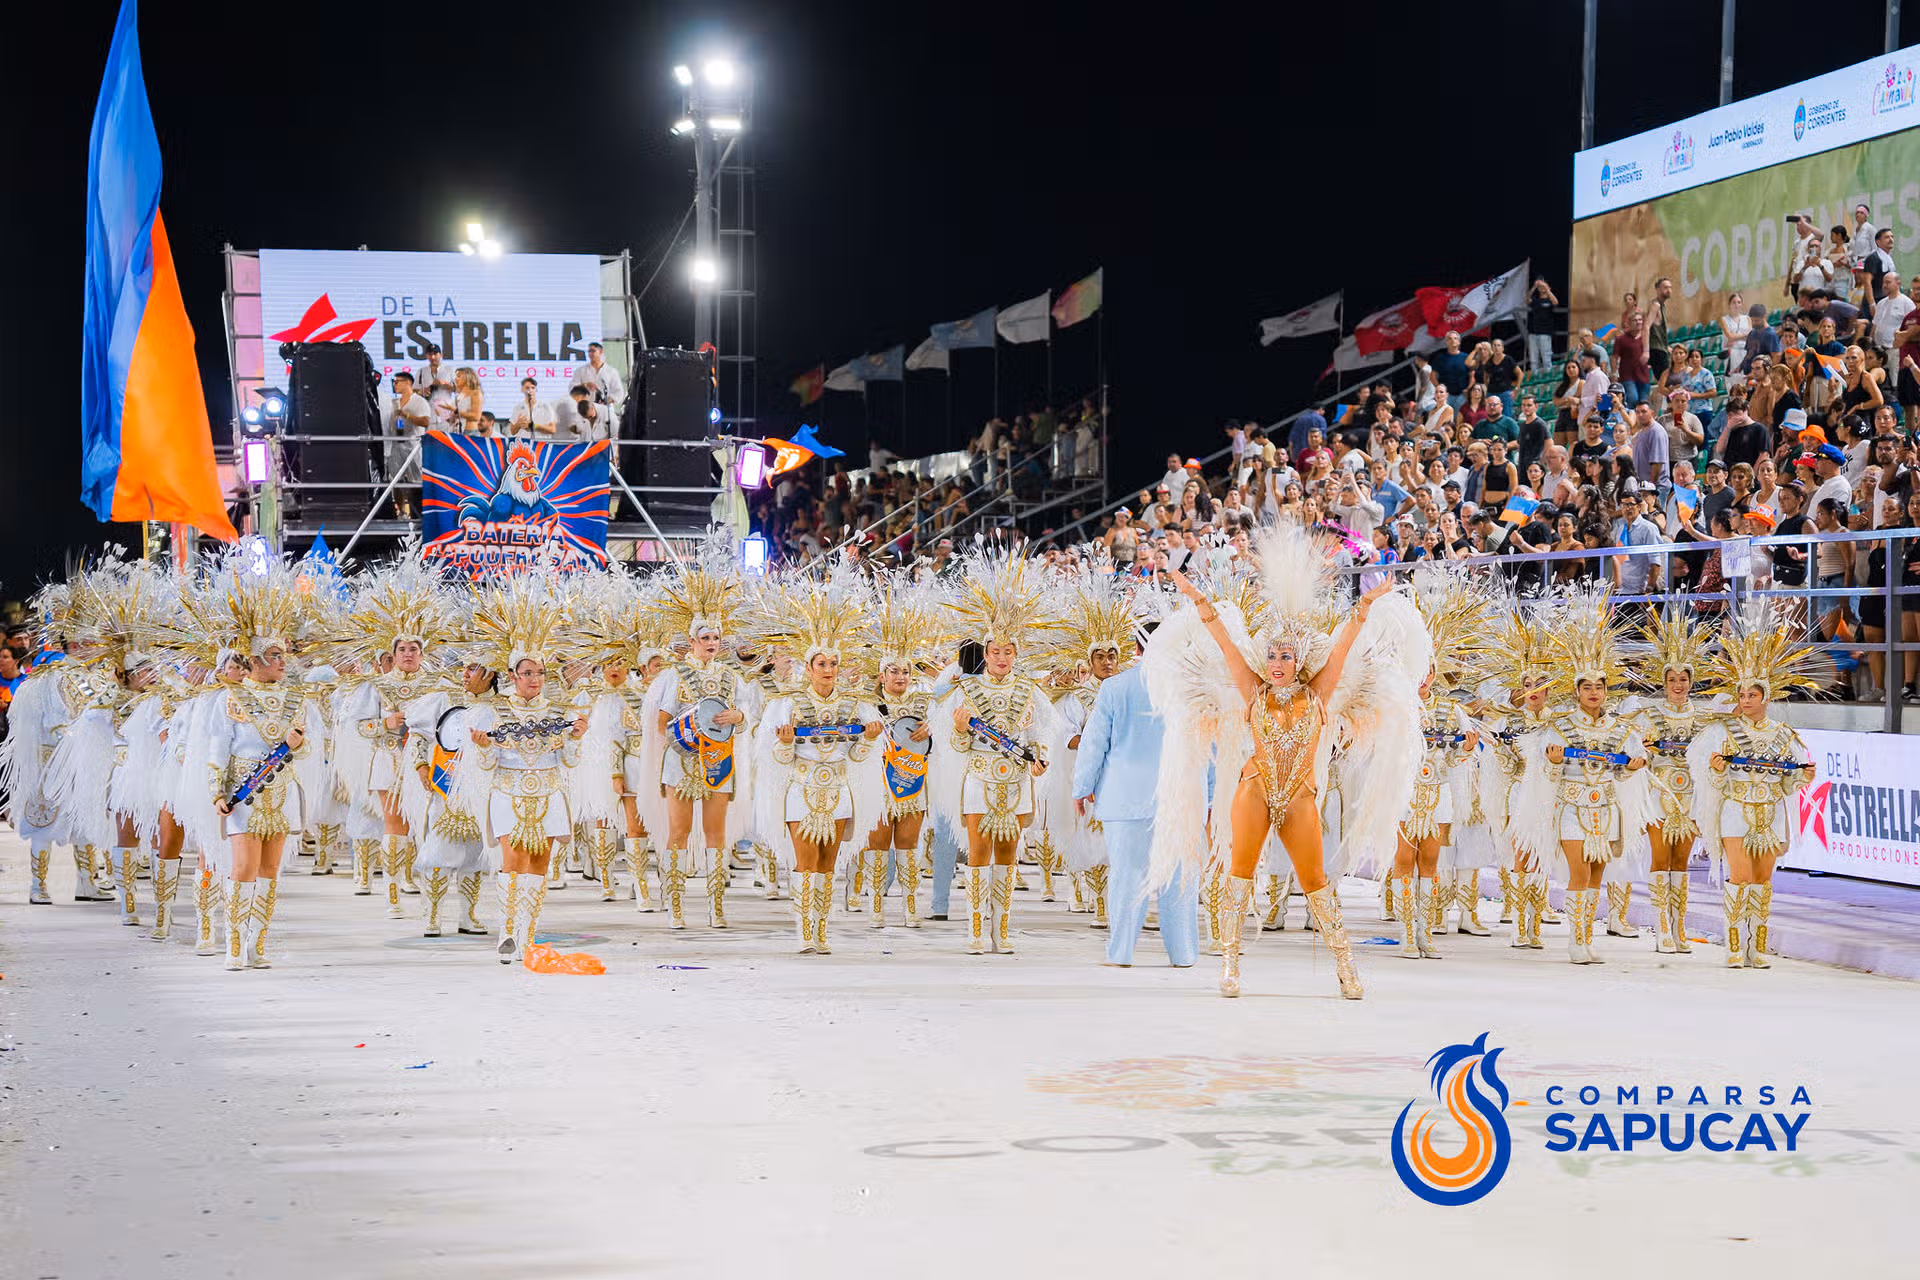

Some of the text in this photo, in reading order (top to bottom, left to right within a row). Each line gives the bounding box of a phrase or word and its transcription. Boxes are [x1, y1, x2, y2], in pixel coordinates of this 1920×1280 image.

[1807, 108, 1847, 131] CORRIENTES
[1808, 101, 1833, 117] GOBIERNO
[1708, 132, 1724, 149] Juan
[1725, 127, 1743, 144] Pablo
[1611, 169, 1644, 188] CORRIENTES
[381, 296, 458, 317] DE LA
[383, 319, 588, 362] ESTRELLA
[1827, 752, 1861, 779] DE LA
[1830, 782, 1920, 843] ESTRELLA
